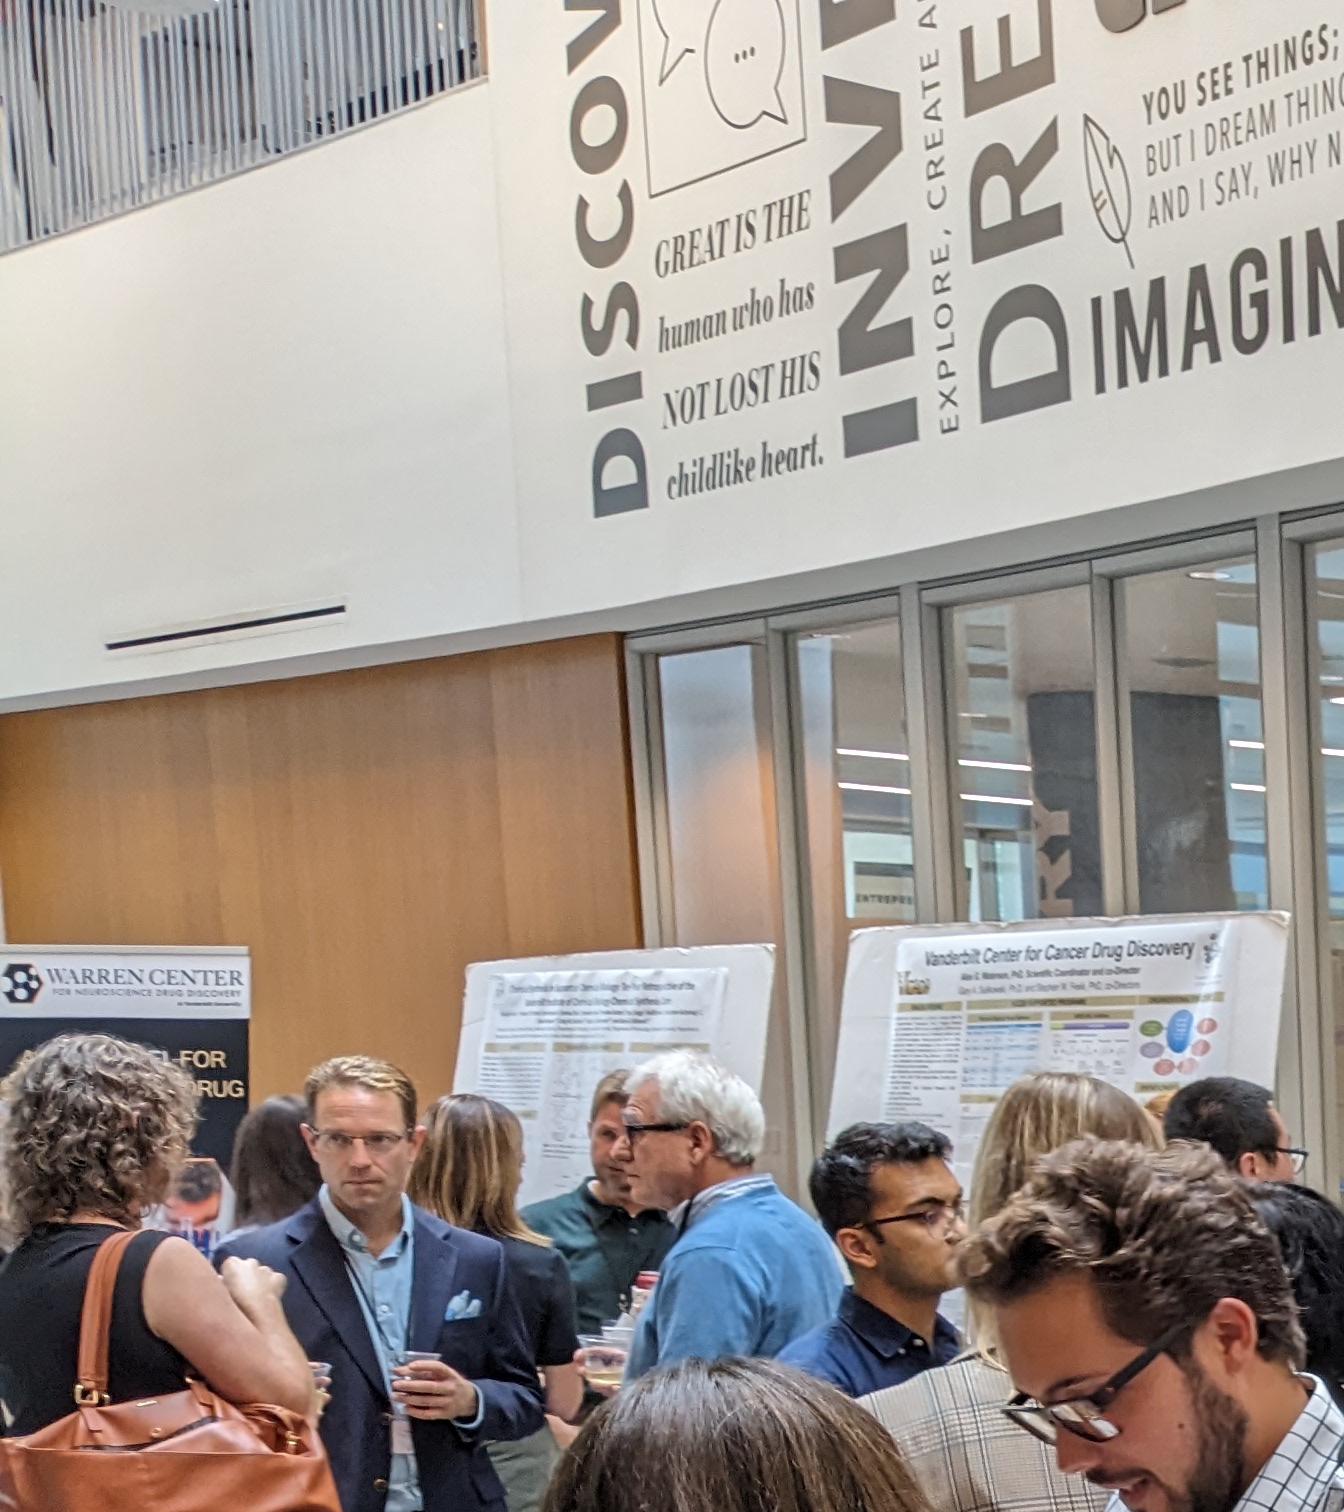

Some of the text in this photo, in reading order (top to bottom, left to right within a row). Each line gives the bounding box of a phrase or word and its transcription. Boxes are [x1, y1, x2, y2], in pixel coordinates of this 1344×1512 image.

[1142, 82, 1187, 125] YOU
[1196, 70, 1235, 112] SEE
[1242, 25, 1342, 89] THINGS;
[919, 48, 948, 211] CREATE
[1145, 127, 1184, 177] BUT
[1189, 126, 1197, 162] I
[1204, 101, 1277, 158] DREAM
[1147, 189, 1190, 229] AND
[1199, 178, 1206, 212] I
[1214, 160, 1261, 208] SAY,
[1266, 132, 1320, 190] WHY
[654, 188, 813, 279] GREAT IS THE
[657, 276, 815, 354] human who has
[929, 228, 959, 434] EXPLORE,
[662, 349, 822, 430] NOT LOST HIS
[666, 432, 825, 502] childlike heart.
[46, 967, 245, 988] WARREN CENTER
[924, 939, 1196, 968] Vanderbilt Center for Cancer Drug Discovery
[52, 988, 241, 998] FOR NEUROSCIENCE DRUG DISCOVERY
[179, 1050, 227, 1069] FOR
